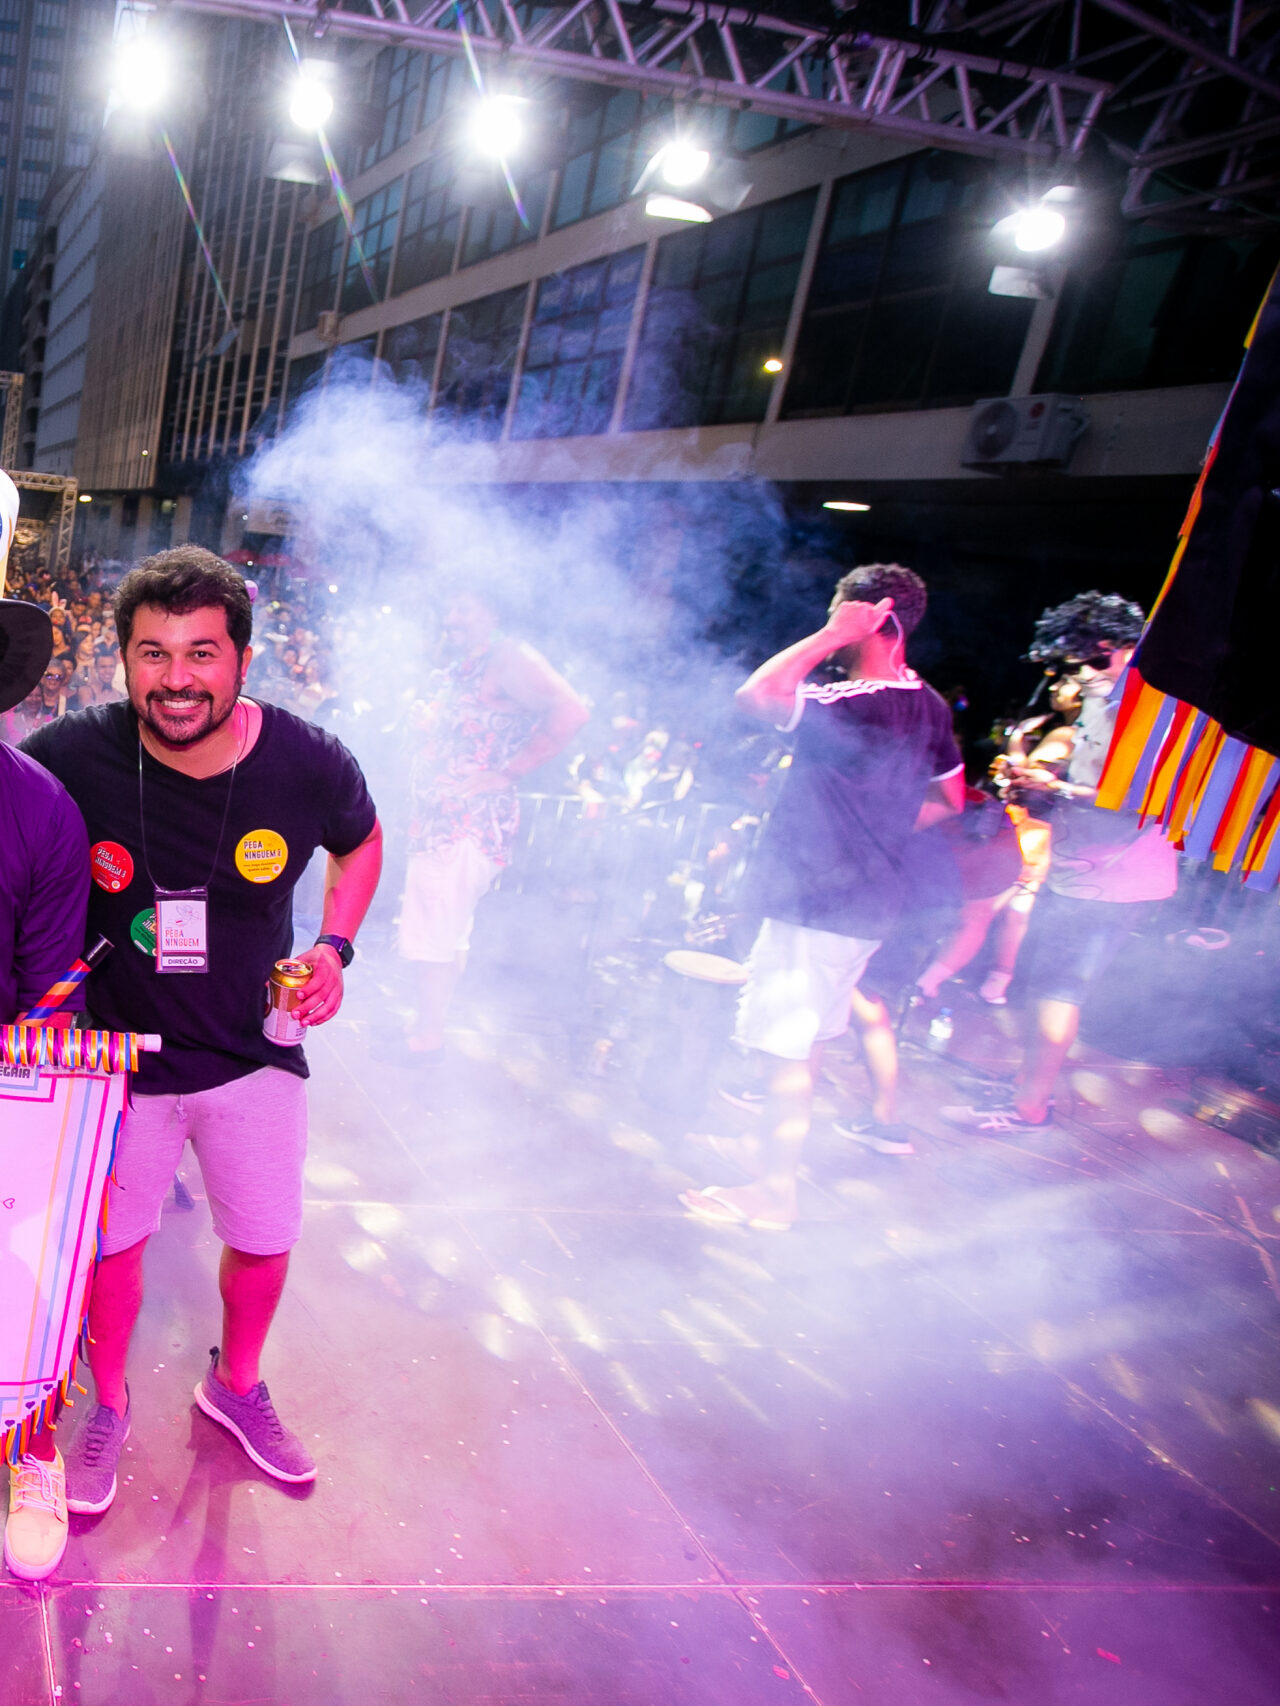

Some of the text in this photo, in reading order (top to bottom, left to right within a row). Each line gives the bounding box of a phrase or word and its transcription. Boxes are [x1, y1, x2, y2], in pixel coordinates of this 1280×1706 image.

[243, 840, 263, 850] PEGA
[244, 850, 276, 860] NINGUEM
[165, 929, 184, 938] PEGA
[165, 938, 199, 947] NINGUEM
